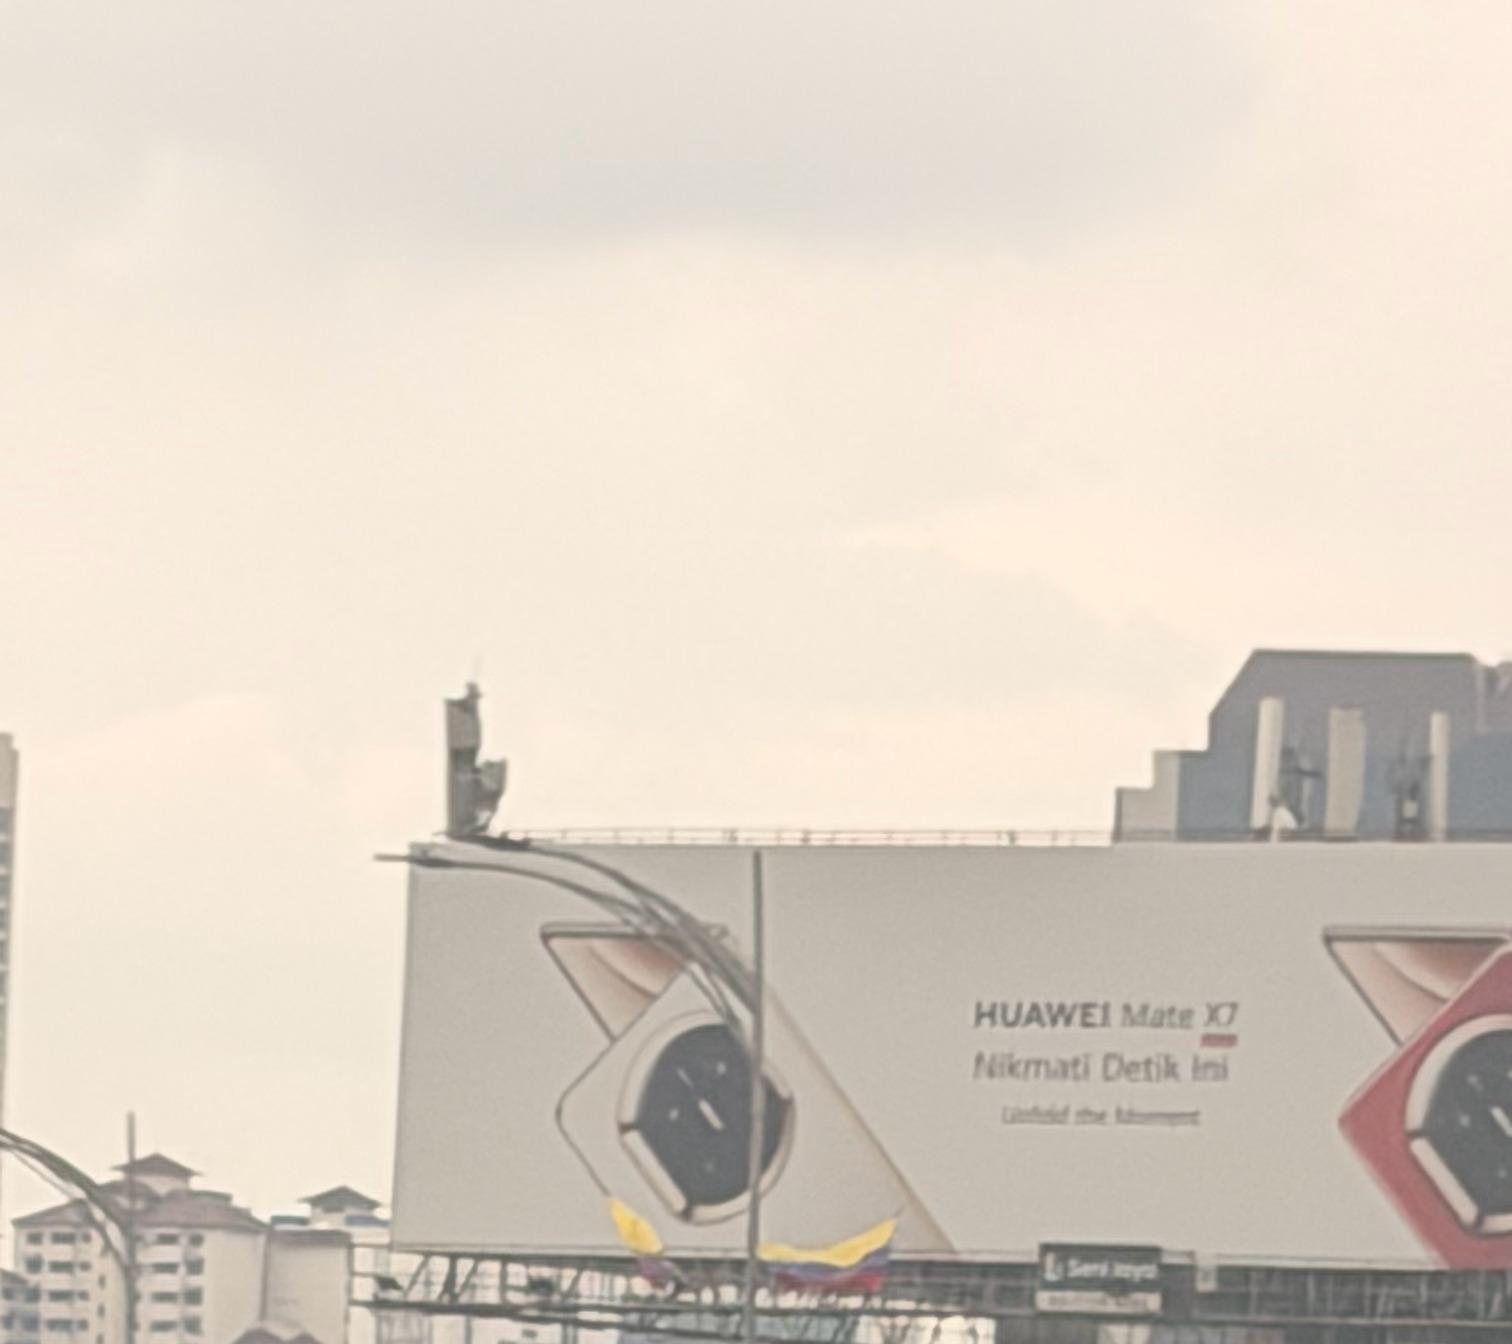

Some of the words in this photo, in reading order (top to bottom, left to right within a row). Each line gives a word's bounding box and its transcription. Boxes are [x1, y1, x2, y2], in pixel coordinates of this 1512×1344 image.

[973, 1001, 1111, 1028] HUAWEI
[1121, 1003, 1195, 1028] Mate
[1203, 1002, 1239, 1027] X7
[973, 1052, 1090, 1080] Nikmati
[1102, 1053, 1180, 1081] Detik
[1191, 1055, 1229, 1080] Ini
